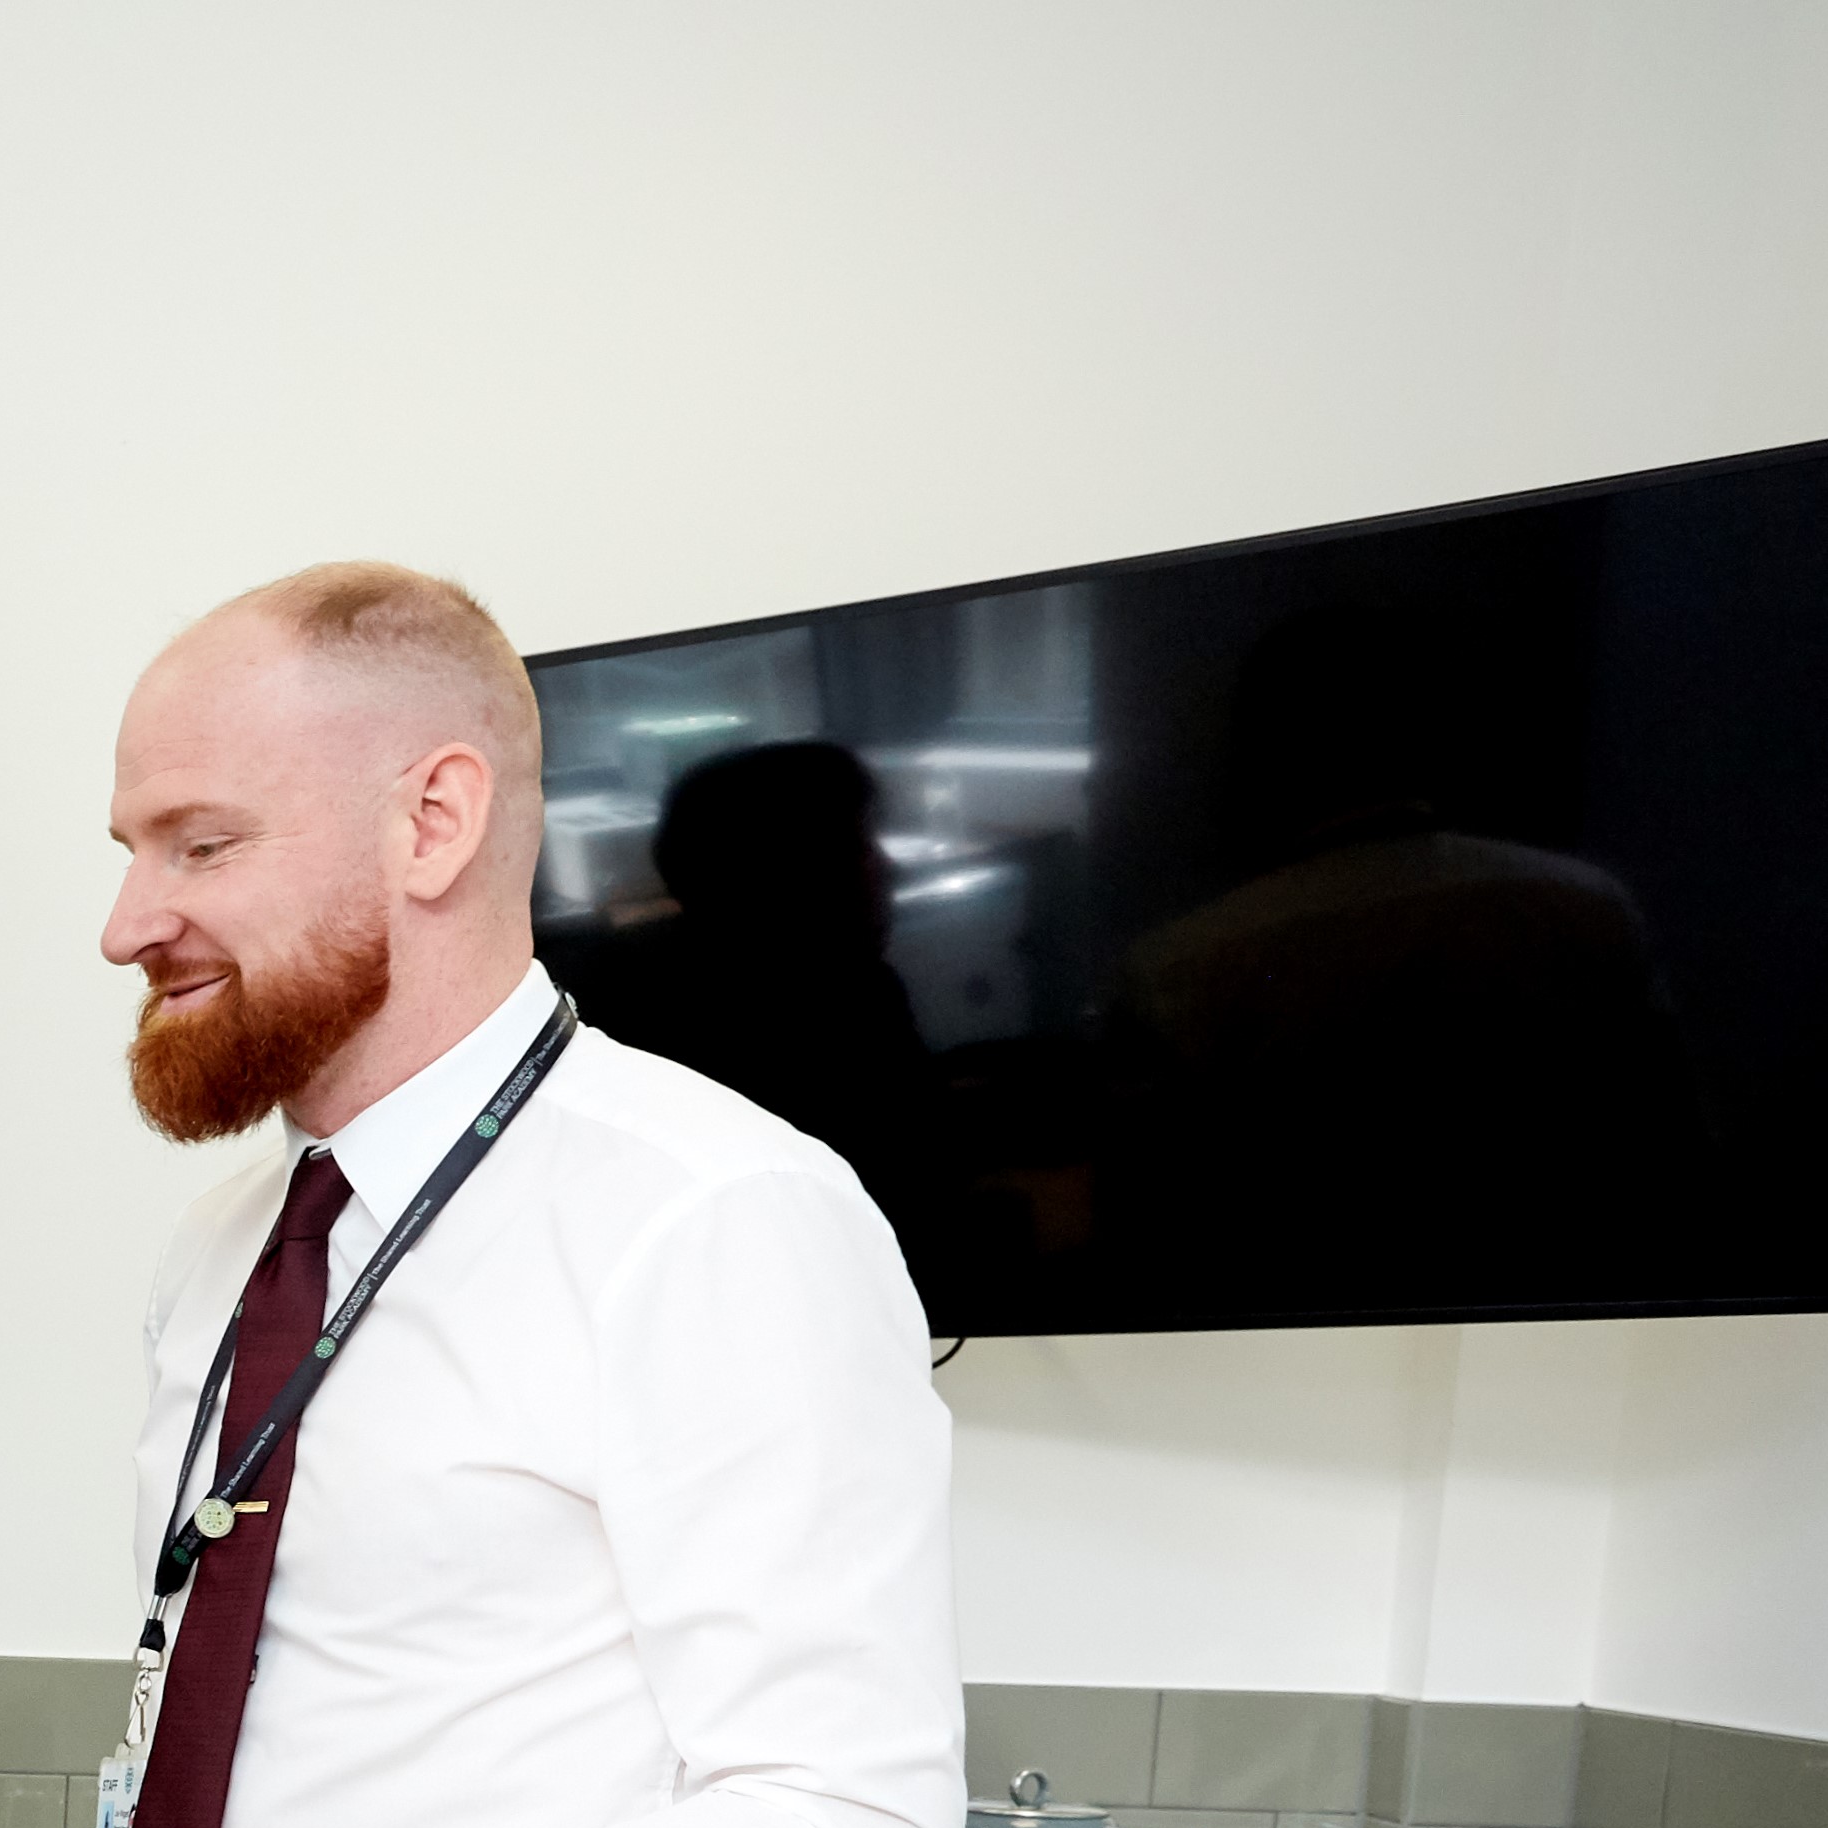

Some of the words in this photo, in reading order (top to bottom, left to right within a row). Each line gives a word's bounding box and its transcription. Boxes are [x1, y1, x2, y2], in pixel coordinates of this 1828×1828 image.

[490, 1098, 503, 1113] THE
[372, 1262, 384, 1275] The
[382, 1241, 398, 1263] Shared
[396, 1214, 420, 1242] Learning
[415, 1198, 431, 1216] Trust
[220, 1485, 232, 1498] The
[228, 1464, 246, 1487] Shared
[242, 1438, 265, 1466] Learning
[260, 1422, 275, 1439] Trust
